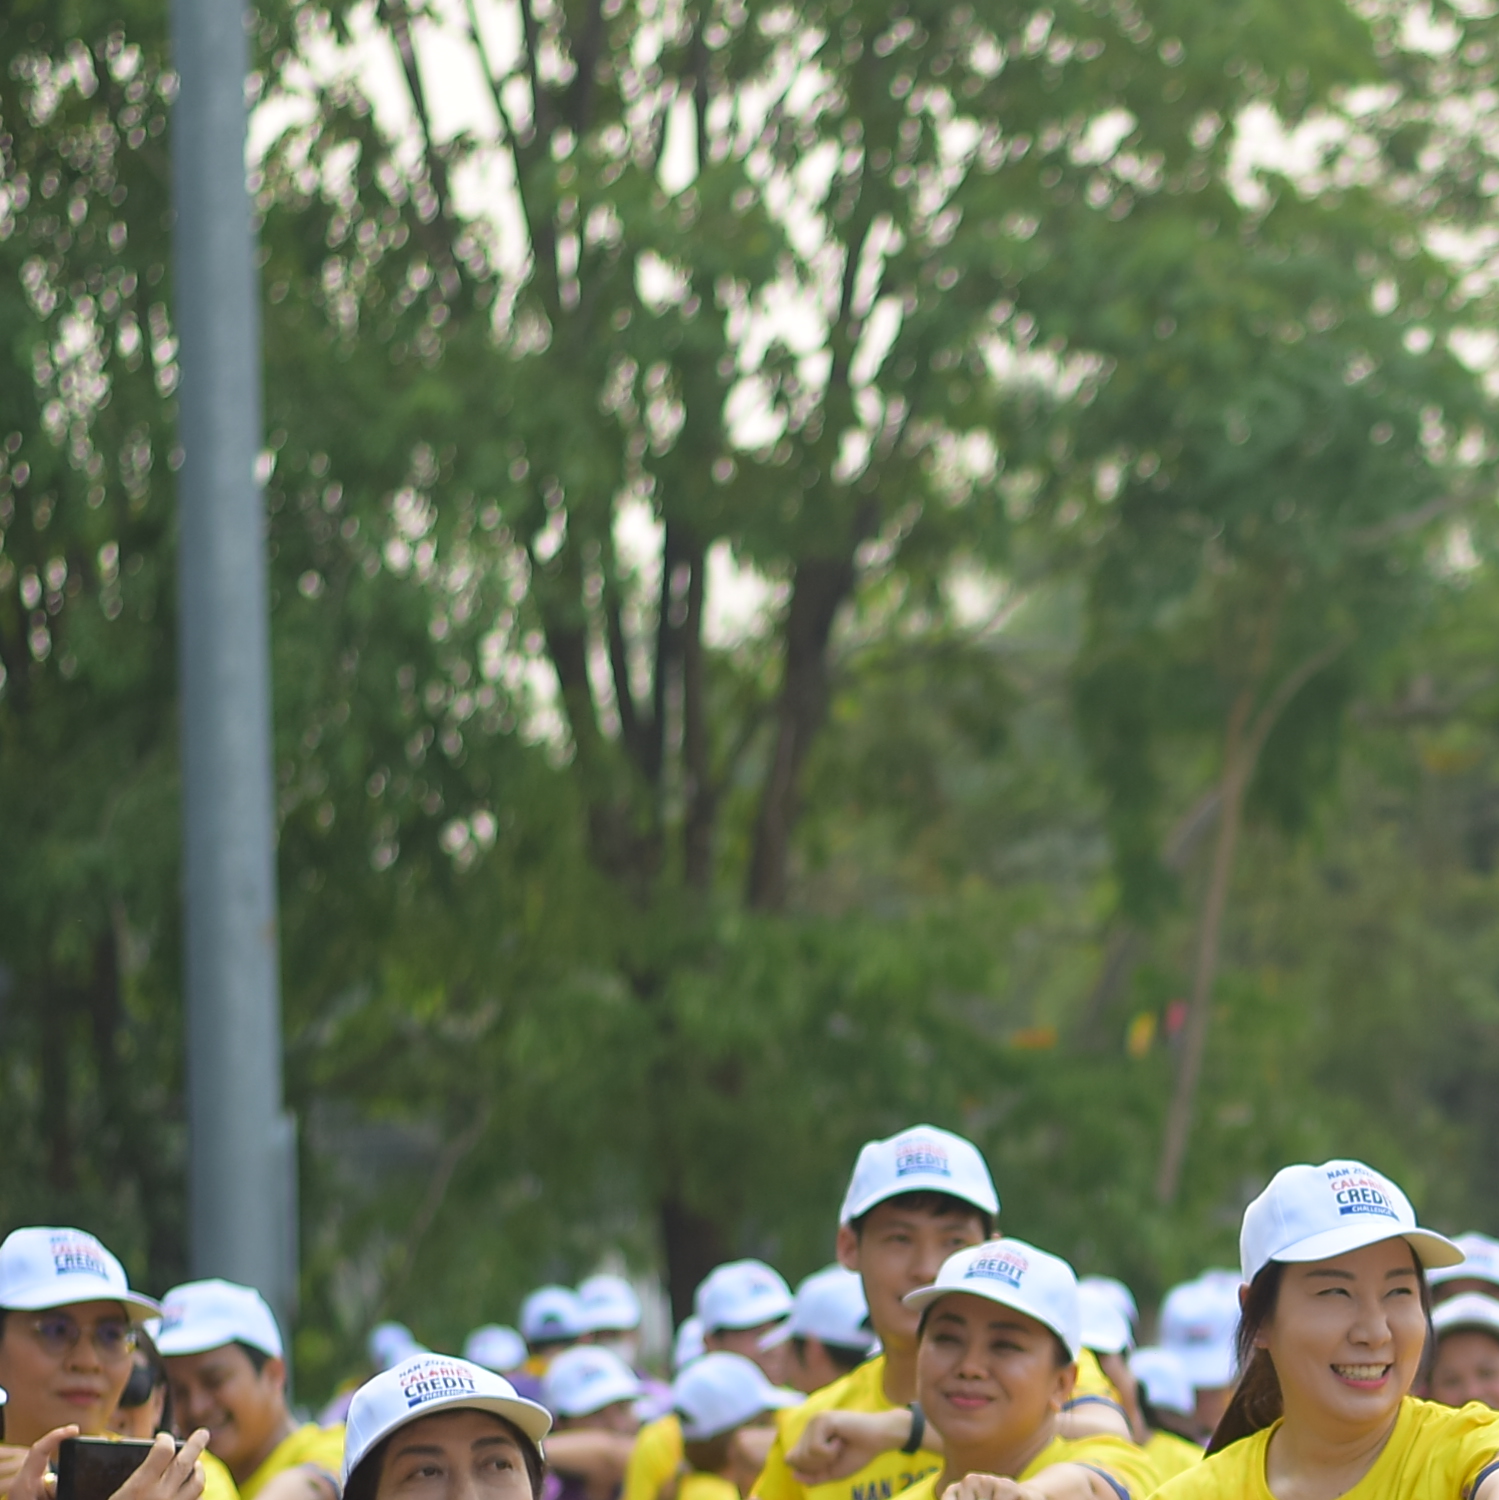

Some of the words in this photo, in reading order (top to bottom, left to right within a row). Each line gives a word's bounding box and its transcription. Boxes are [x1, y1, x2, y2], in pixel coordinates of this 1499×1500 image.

[1327, 1168, 1350, 1179] NAN
[968, 1259, 1025, 1280] CREDIT
[404, 1377, 475, 1398] CREDIT
